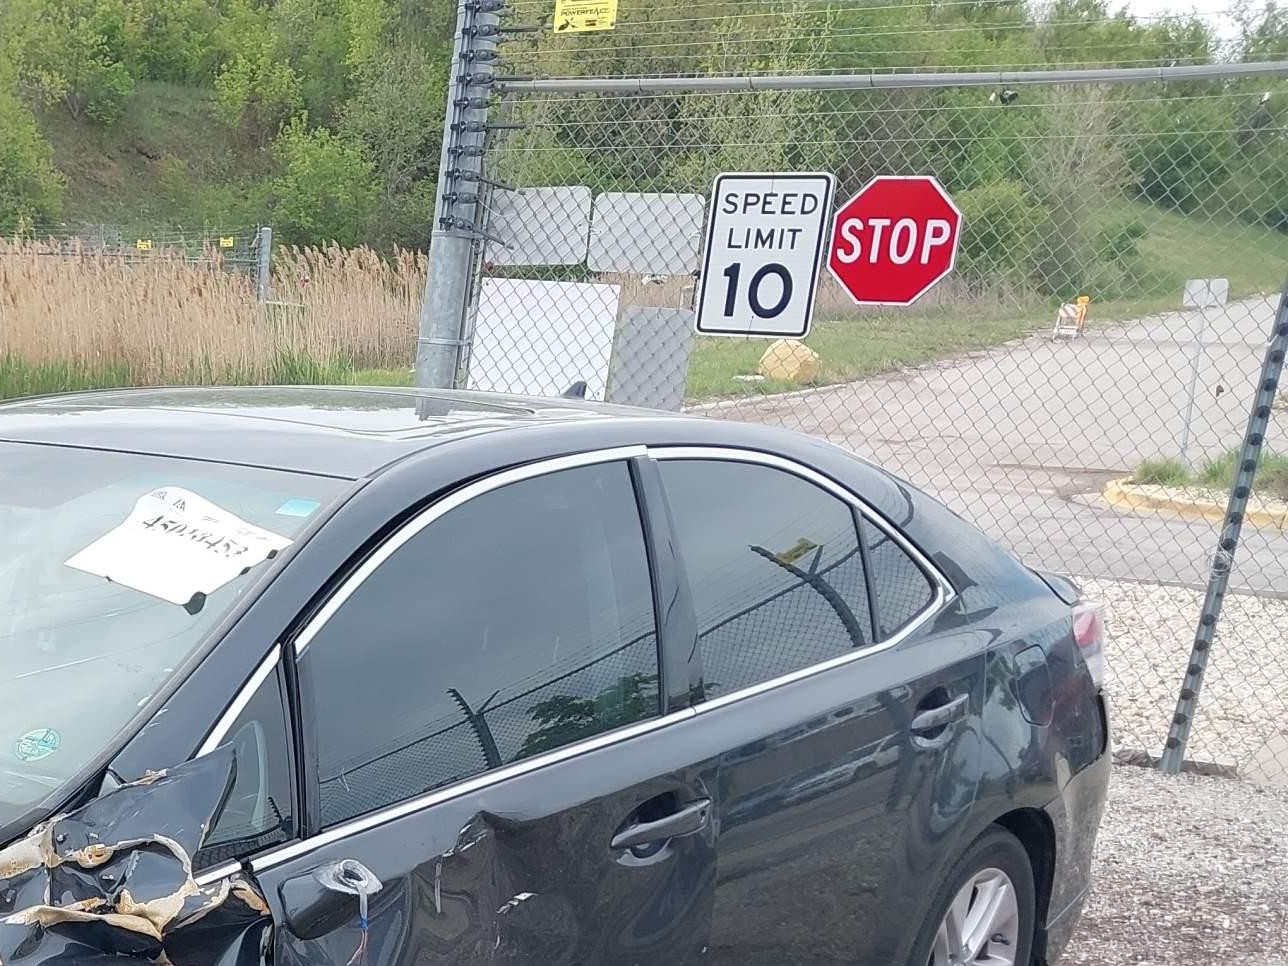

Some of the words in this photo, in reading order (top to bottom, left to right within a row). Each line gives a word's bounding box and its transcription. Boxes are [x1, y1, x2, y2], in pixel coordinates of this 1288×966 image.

[722, 192, 818, 215] SPEED
[727, 227, 803, 250] LIMIT
[836, 217, 951, 265] STOP
[722, 262, 794, 319] 10
